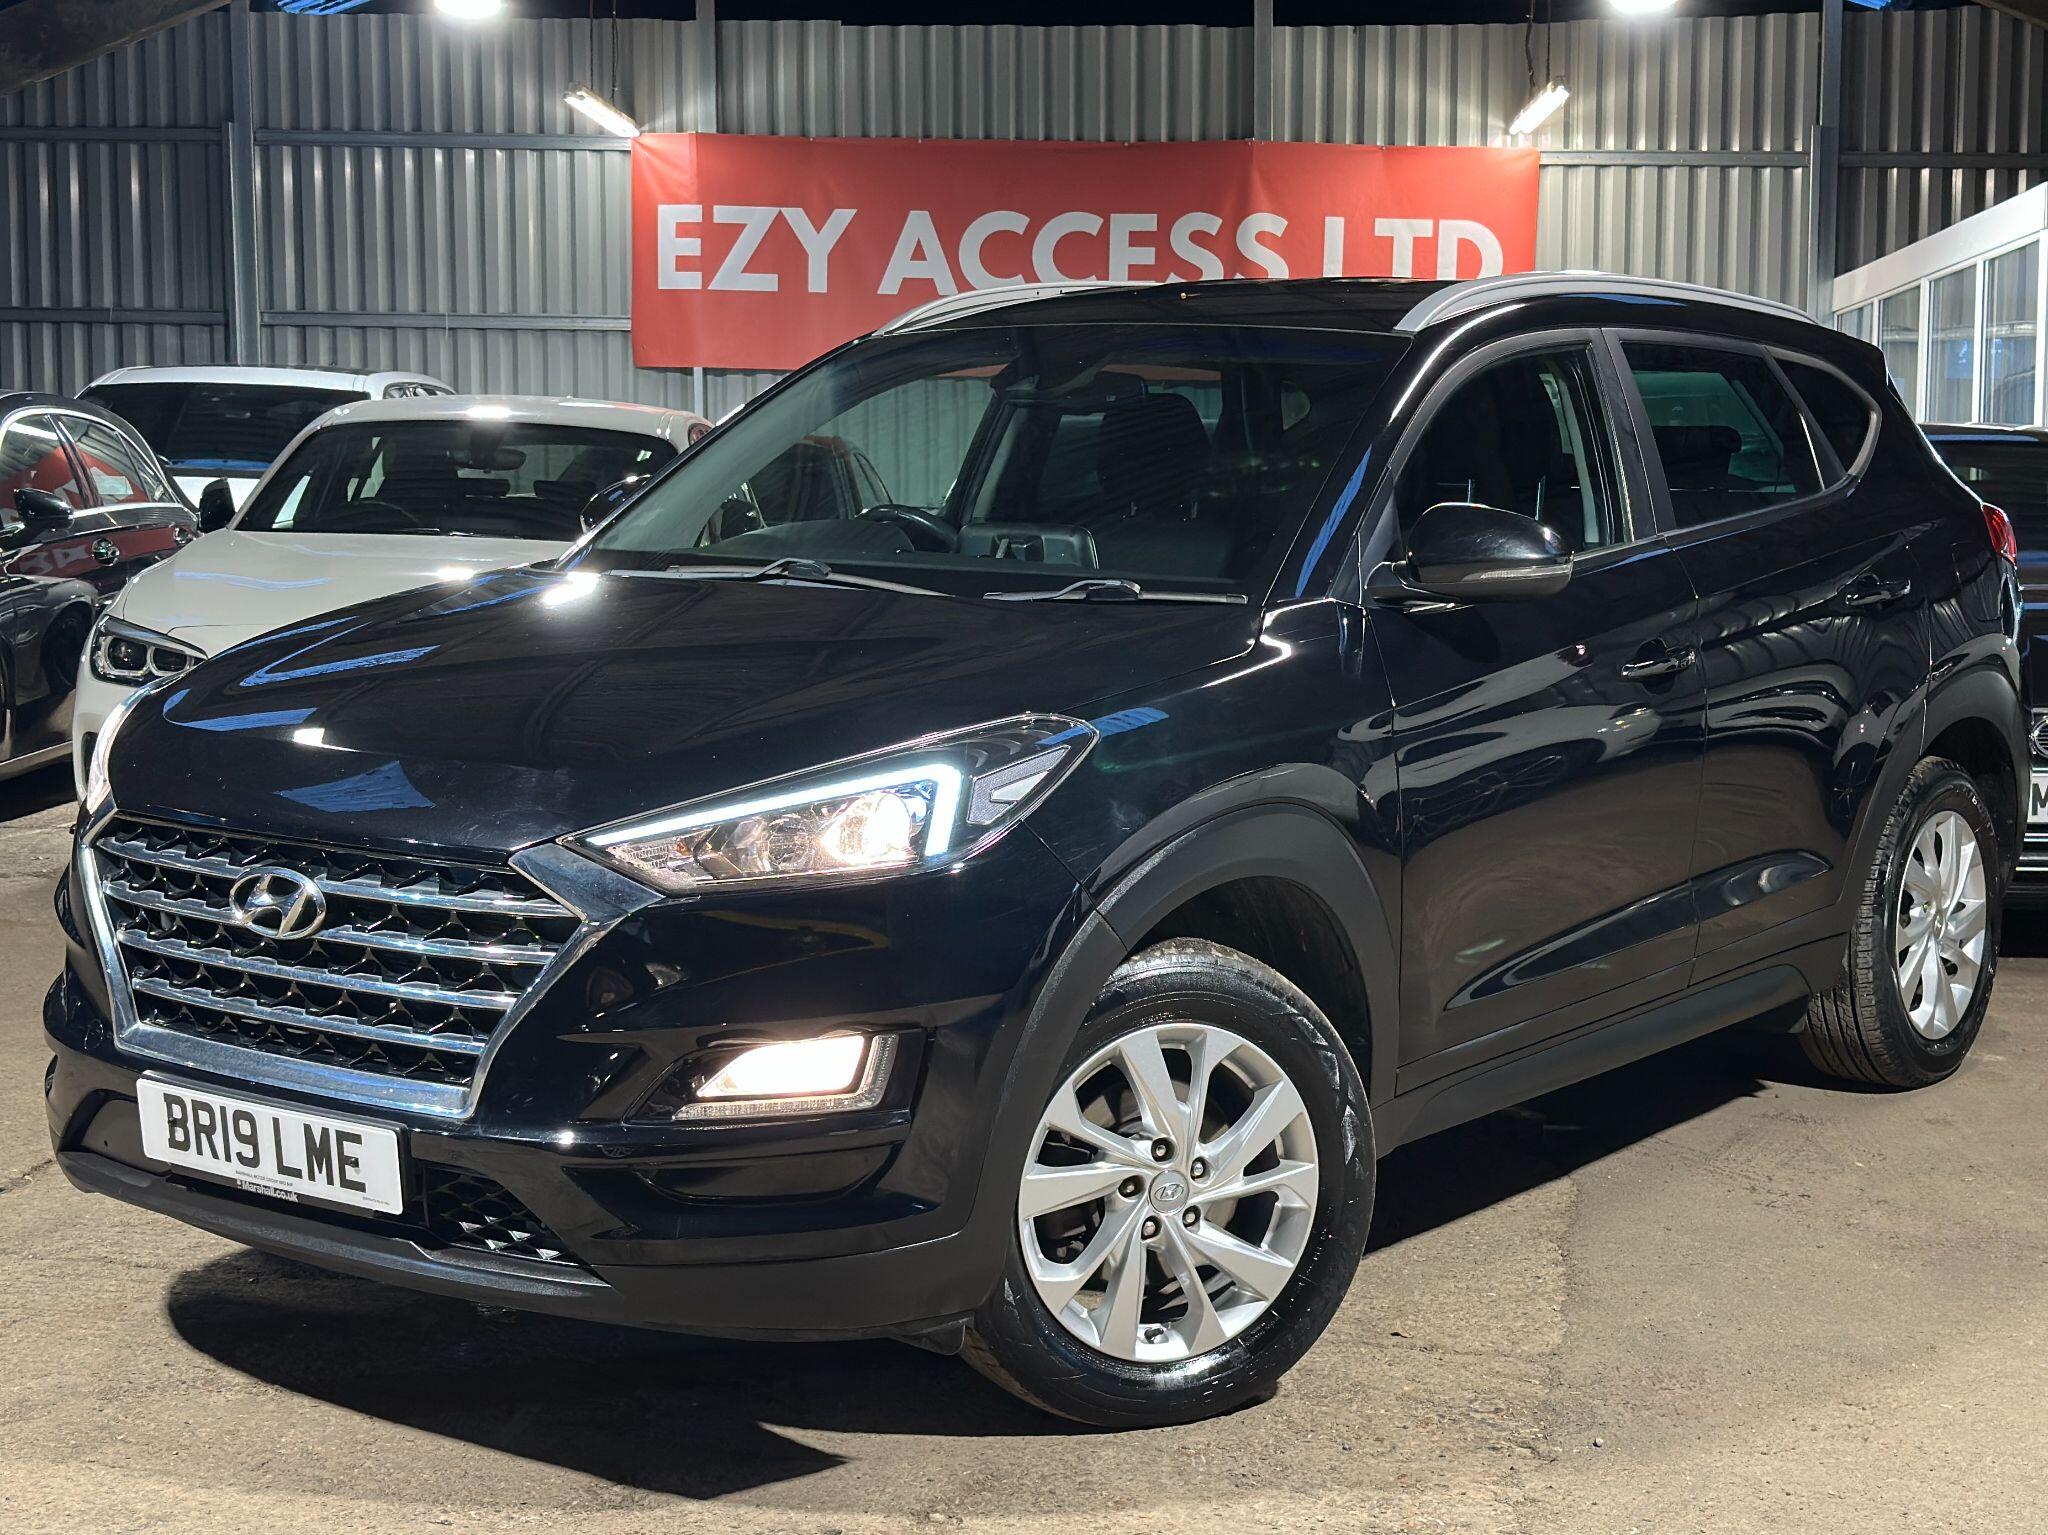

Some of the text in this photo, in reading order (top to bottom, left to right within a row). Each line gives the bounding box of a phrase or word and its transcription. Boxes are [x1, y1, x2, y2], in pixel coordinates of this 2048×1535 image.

[657, 204, 1504, 296] EZY ACCESS LTD
[163, 1092, 367, 1193] BR19 LME
